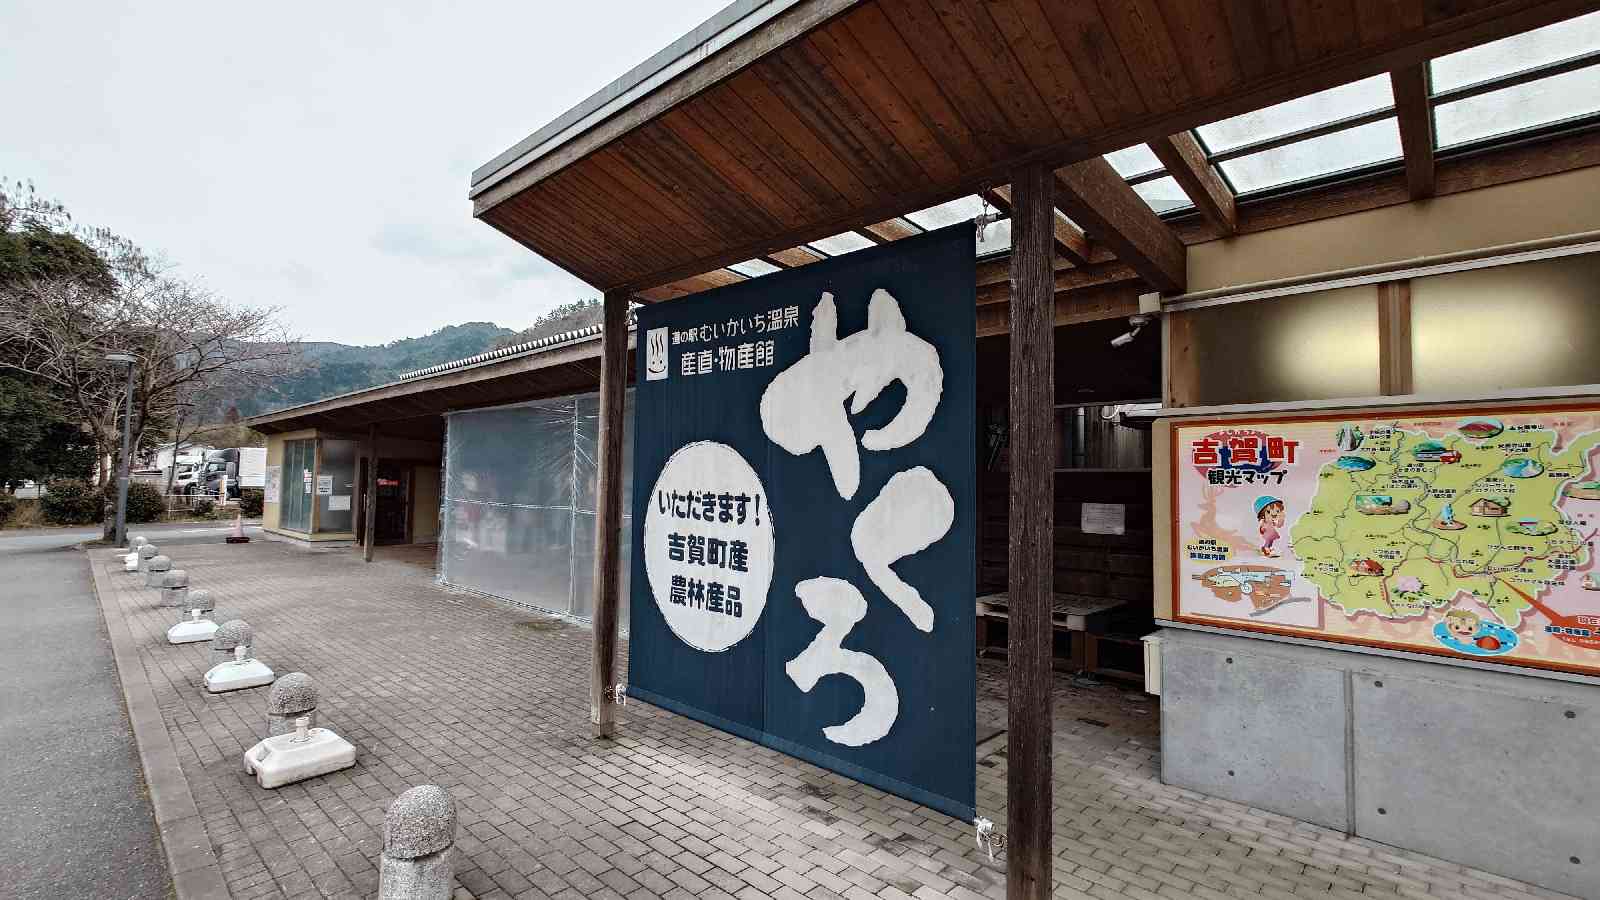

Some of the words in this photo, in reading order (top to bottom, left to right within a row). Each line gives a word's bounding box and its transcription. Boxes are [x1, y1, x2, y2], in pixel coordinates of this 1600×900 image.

[1192, 436, 1299, 464] 吉賀町
[1208, 469, 1288, 485] 観光マップ
[658, 489, 761, 526] いただきます！
[668, 532, 748, 572] 吉賀町産
[669, 574, 743, 618] 農林産品
